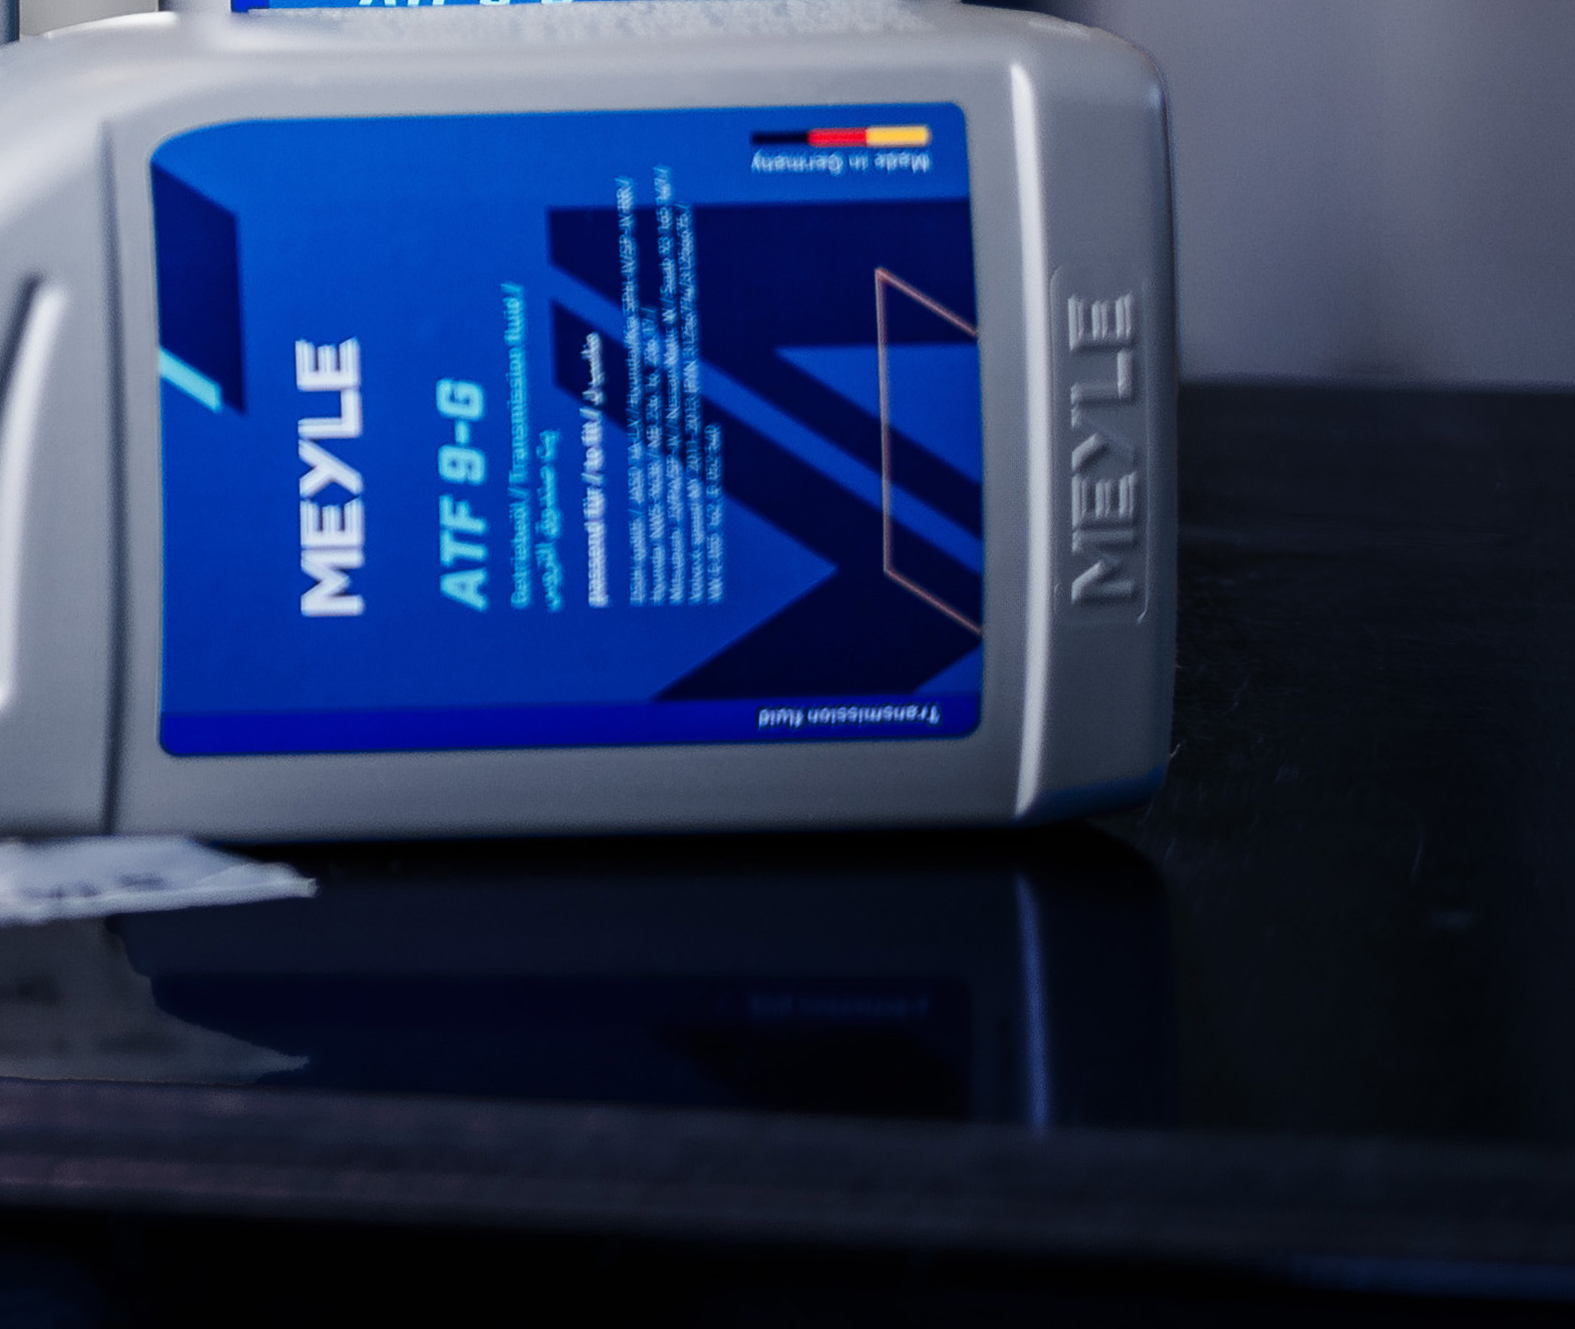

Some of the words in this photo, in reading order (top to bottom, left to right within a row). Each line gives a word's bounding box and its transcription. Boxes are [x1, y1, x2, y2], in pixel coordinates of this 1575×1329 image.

[751, 151, 843, 176] Germany
[849, 154, 869, 172] in
[874, 152, 931, 174] Made
[435, 379, 486, 485] 9-G
[1067, 293, 1136, 605] MEYLE
[294, 337, 364, 617] MEYLE
[439, 495, 489, 611] ATF
[808, 704, 940, 725] Transmission
